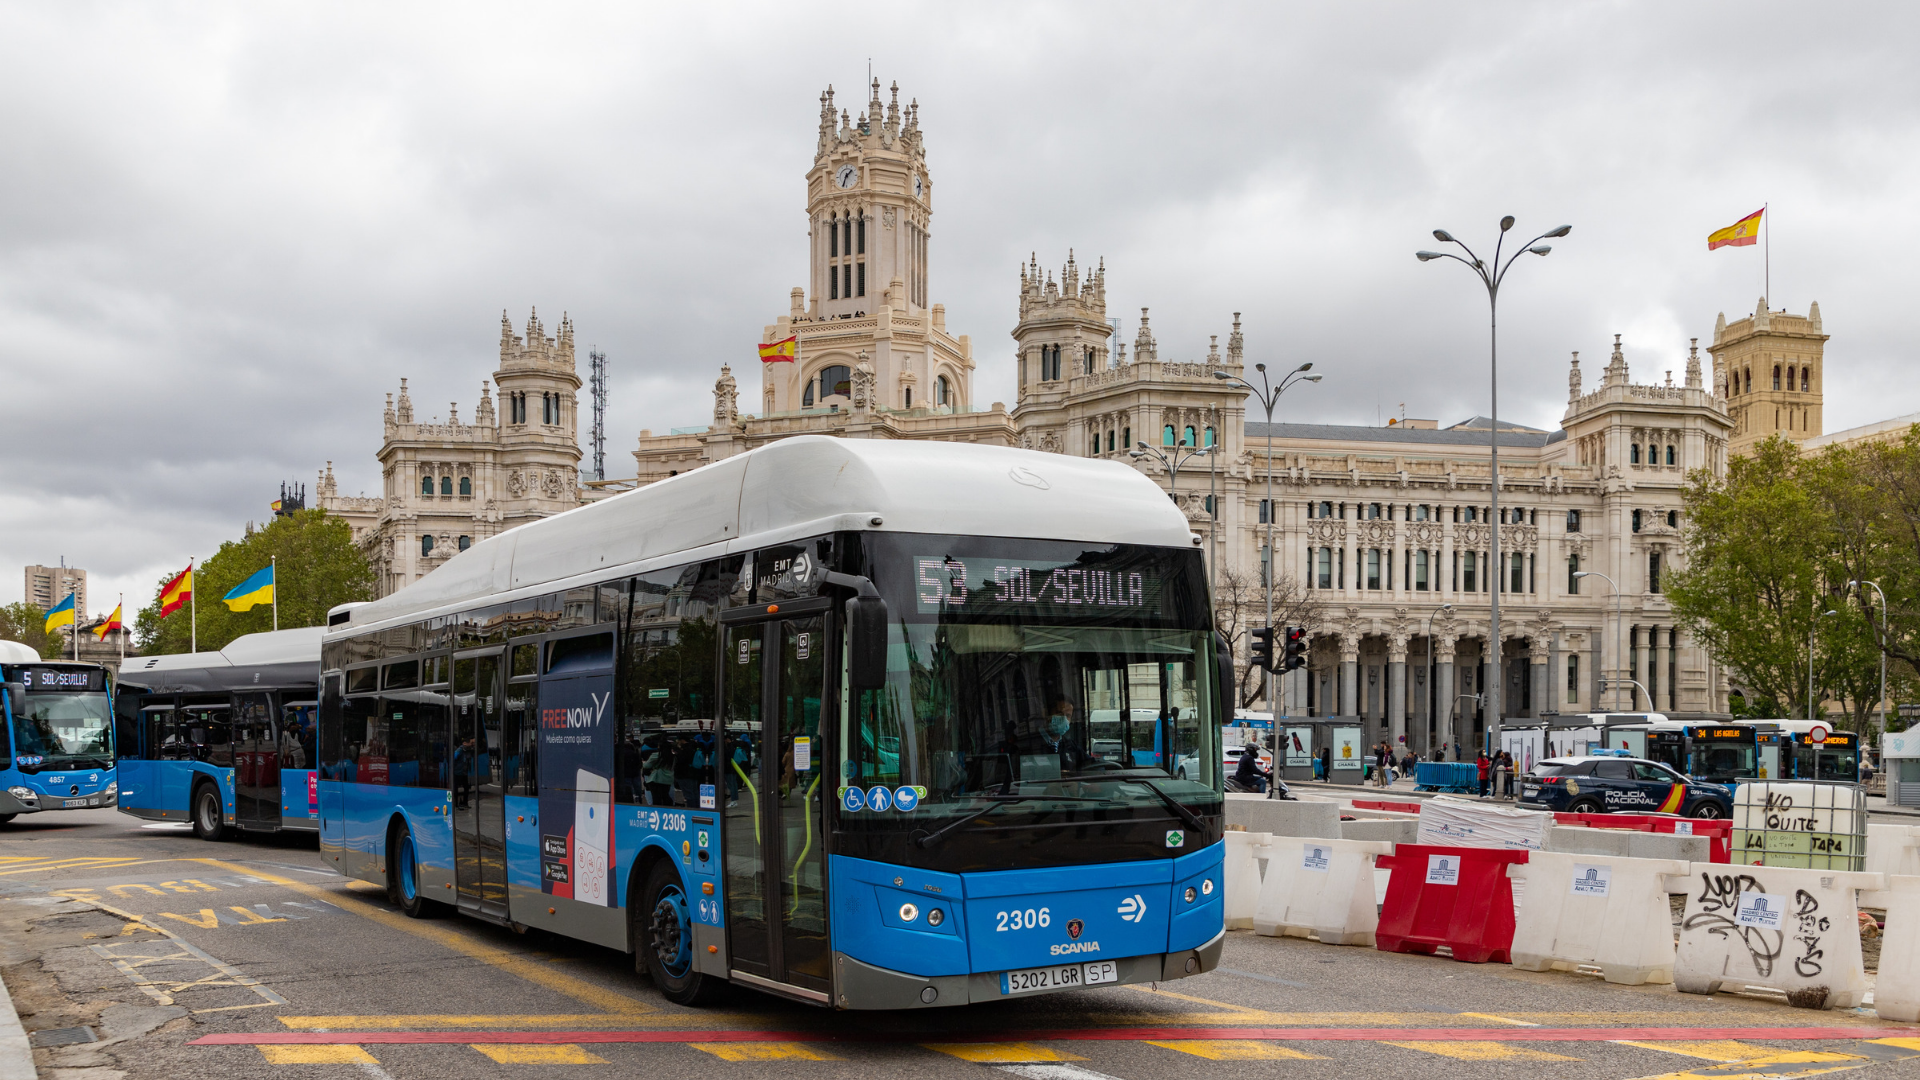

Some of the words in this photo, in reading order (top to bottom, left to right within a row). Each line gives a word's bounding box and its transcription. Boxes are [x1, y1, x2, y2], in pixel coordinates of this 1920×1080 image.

[774, 559, 791, 571] EMT
[760, 572, 791, 587] MADRID
[919, 559, 967, 605] 53
[994, 565, 1143, 606] SOL/SEVILLA
[23, 671, 32, 686] 5
[42, 673, 88, 686] SOL/SEVILLA
[546, 733, 563, 744] Muévete
[563, 735, 575, 744] como
[576, 733, 592, 745] quieras
[1697, 729, 1706, 738] 34
[1713, 730, 1722, 738] LAS
[49, 776, 65, 784] 4857
[839, 788, 844, 796] 2
[918, 788, 924, 796] 3
[1605, 790, 1646, 799] POLICÍA
[1605, 797, 1658, 806] NACIONAL
[1763, 791, 1793, 812] NO
[638, 811, 648, 819] EMT
[662, 813, 686, 832] 2306
[1767, 814, 1818, 831] QUITE
[629, 819, 648, 829] MADRID
[1747, 833, 1763, 849] LA
[1811, 836, 1842, 853] TAPA
[996, 907, 1051, 933] 2306
[1050, 941, 1101, 956] SCANIA
[1011, 971, 1048, 990] 5202
[1052, 967, 1079, 986] LGR
[1090, 964, 1112, 982] SP
